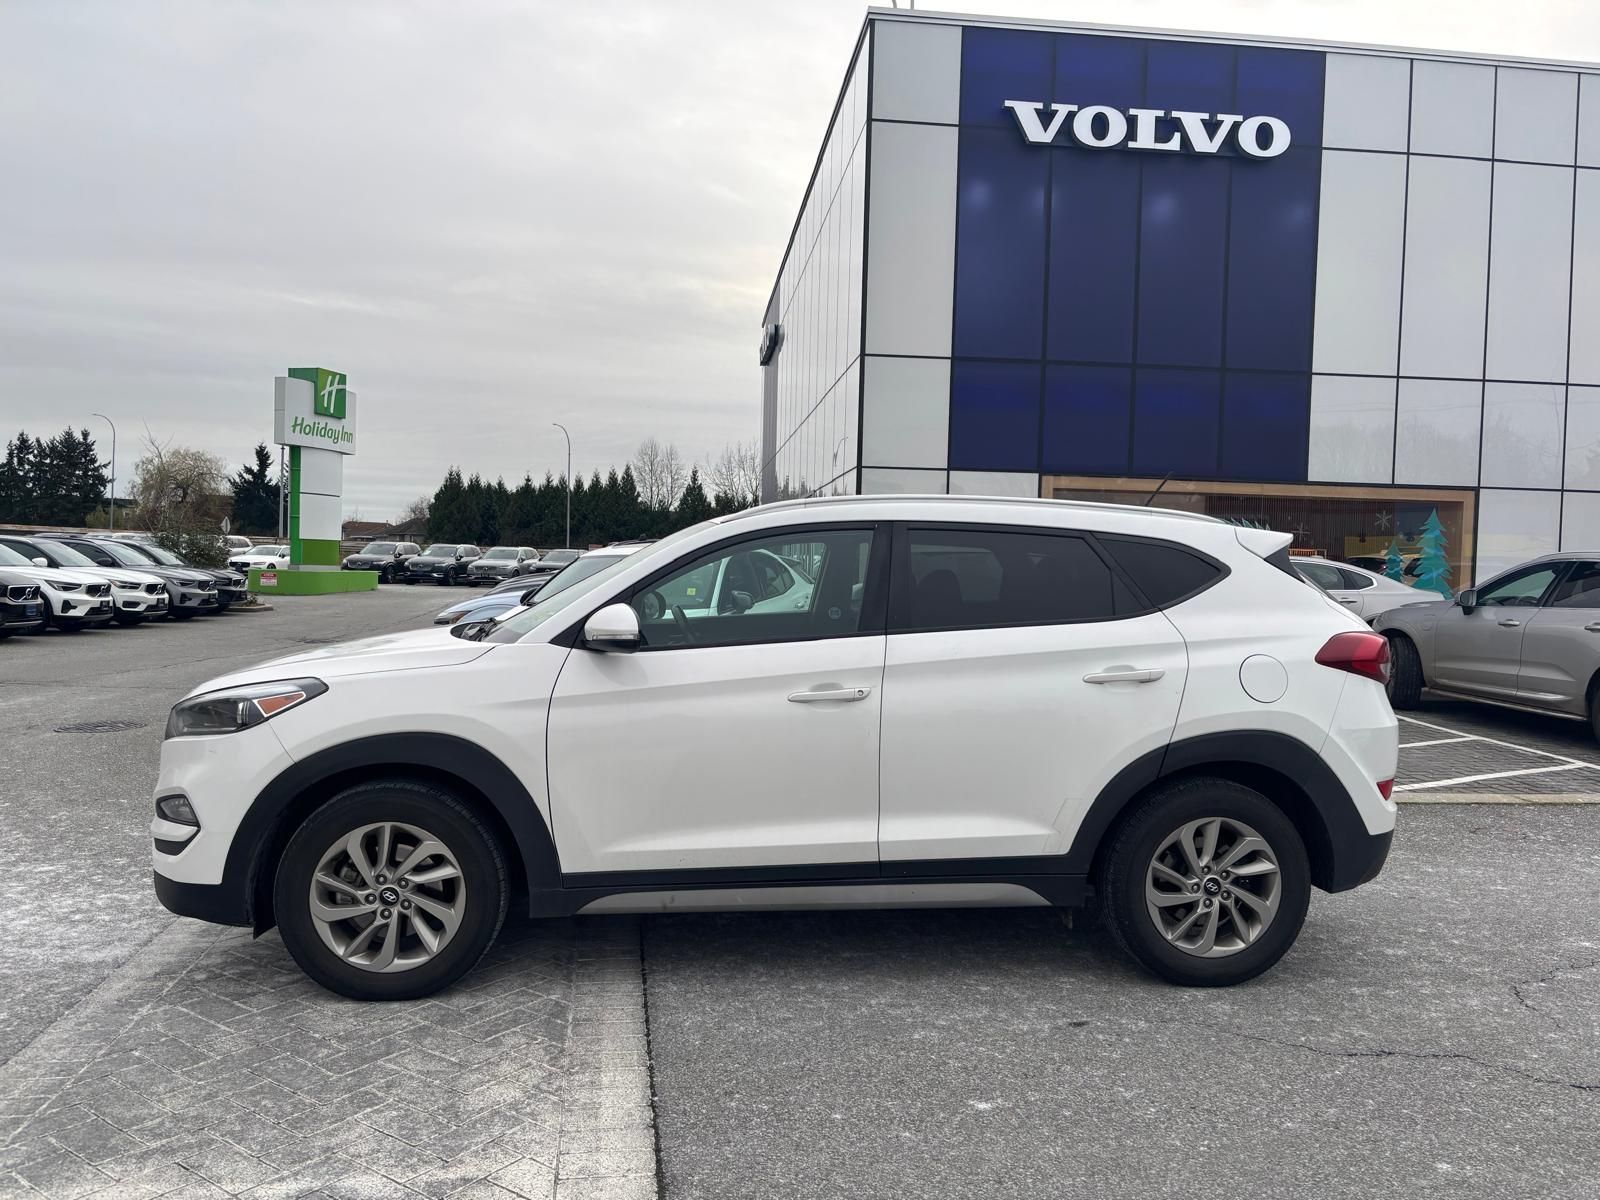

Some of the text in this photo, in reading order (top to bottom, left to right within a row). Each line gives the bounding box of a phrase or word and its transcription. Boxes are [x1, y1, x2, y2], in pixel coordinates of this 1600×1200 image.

[1004, 100, 1291, 157] VOLVO
[291, 416, 353, 444] Holiday Inn
